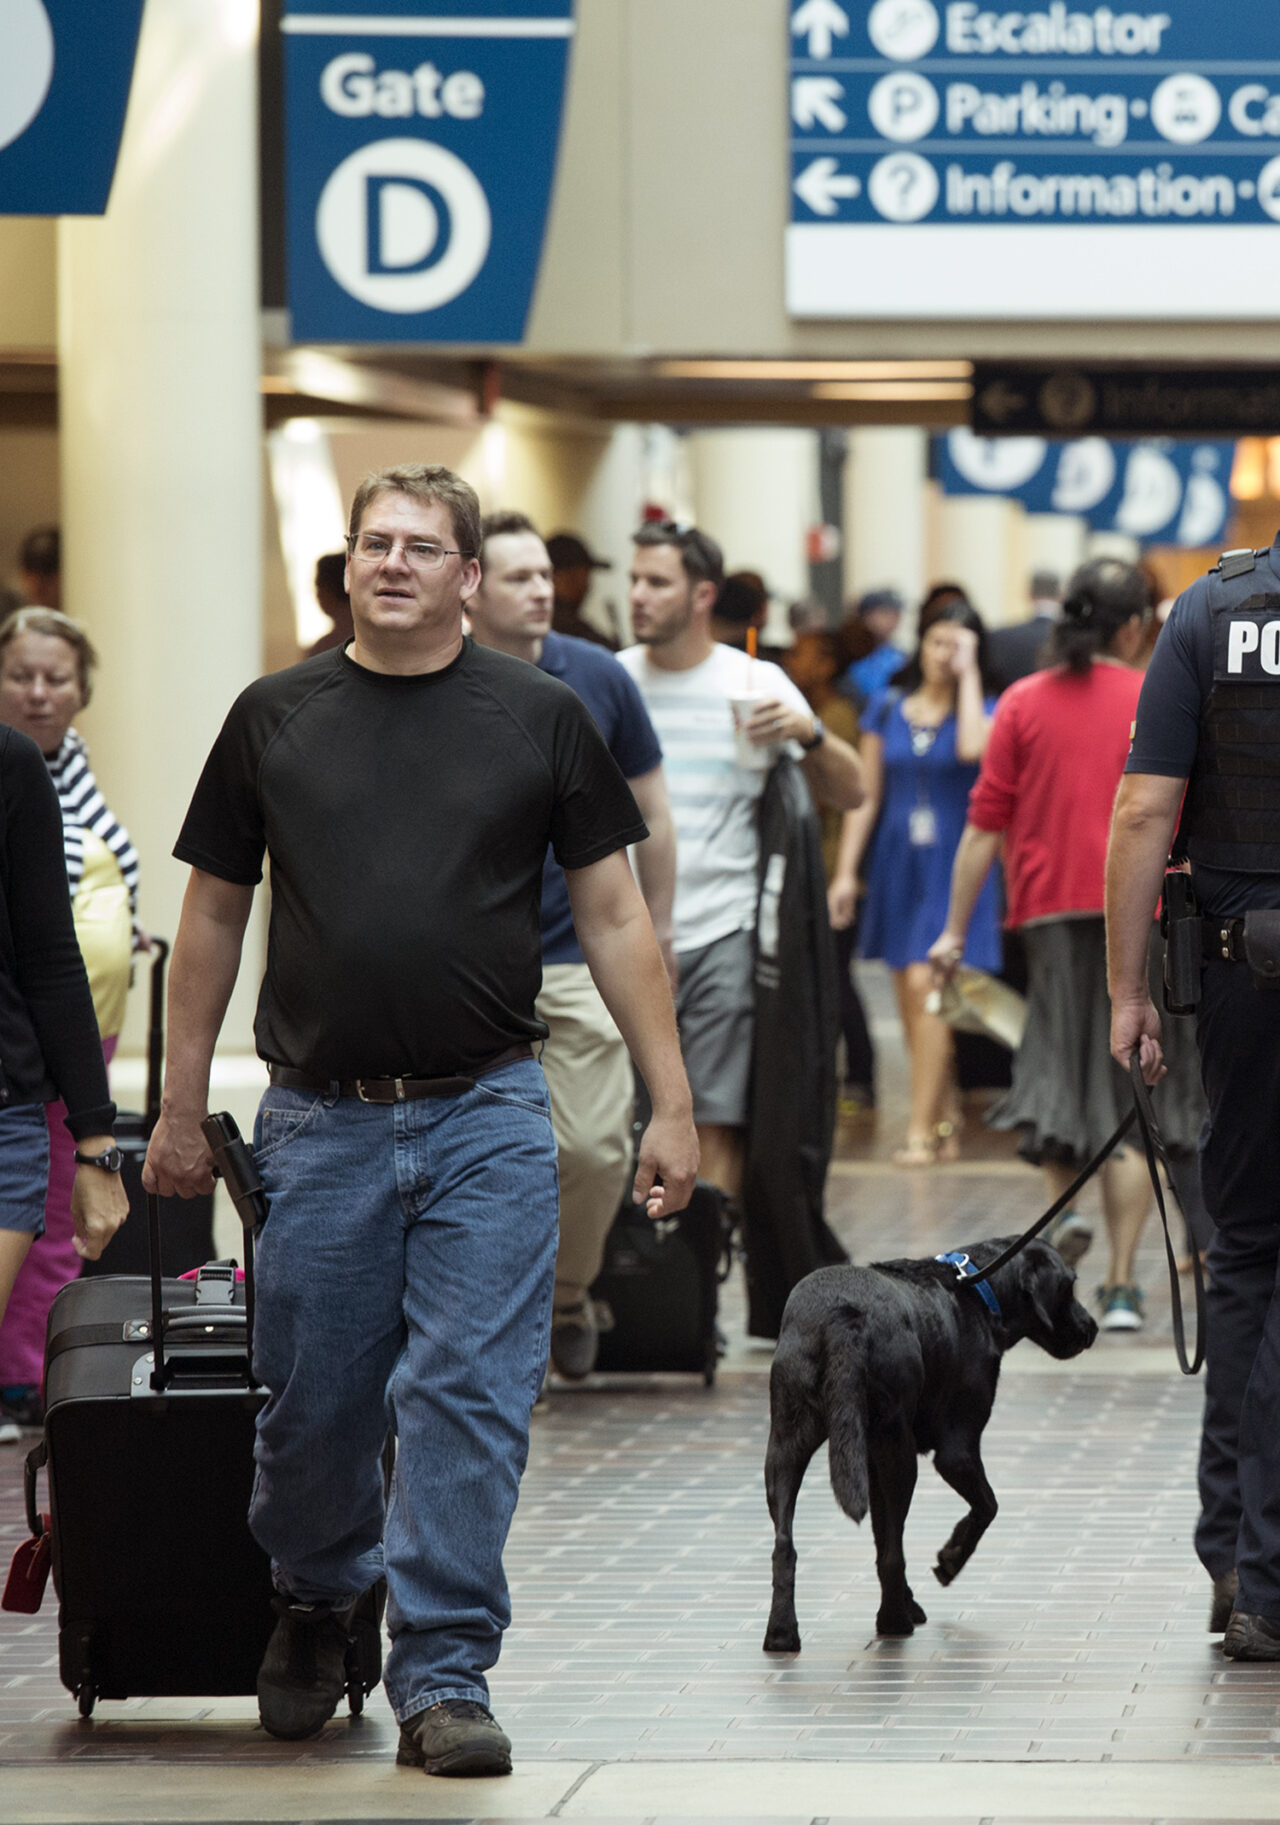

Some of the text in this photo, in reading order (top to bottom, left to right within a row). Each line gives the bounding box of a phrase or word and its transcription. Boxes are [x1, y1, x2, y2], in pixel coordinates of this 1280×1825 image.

[945, 1, 1171, 55] Escalator
[320, 52, 486, 119] Gate
[945, 80, 1128, 148] Parking
[945, 160, 1236, 217] Information
[365, 174, 452, 275] D
